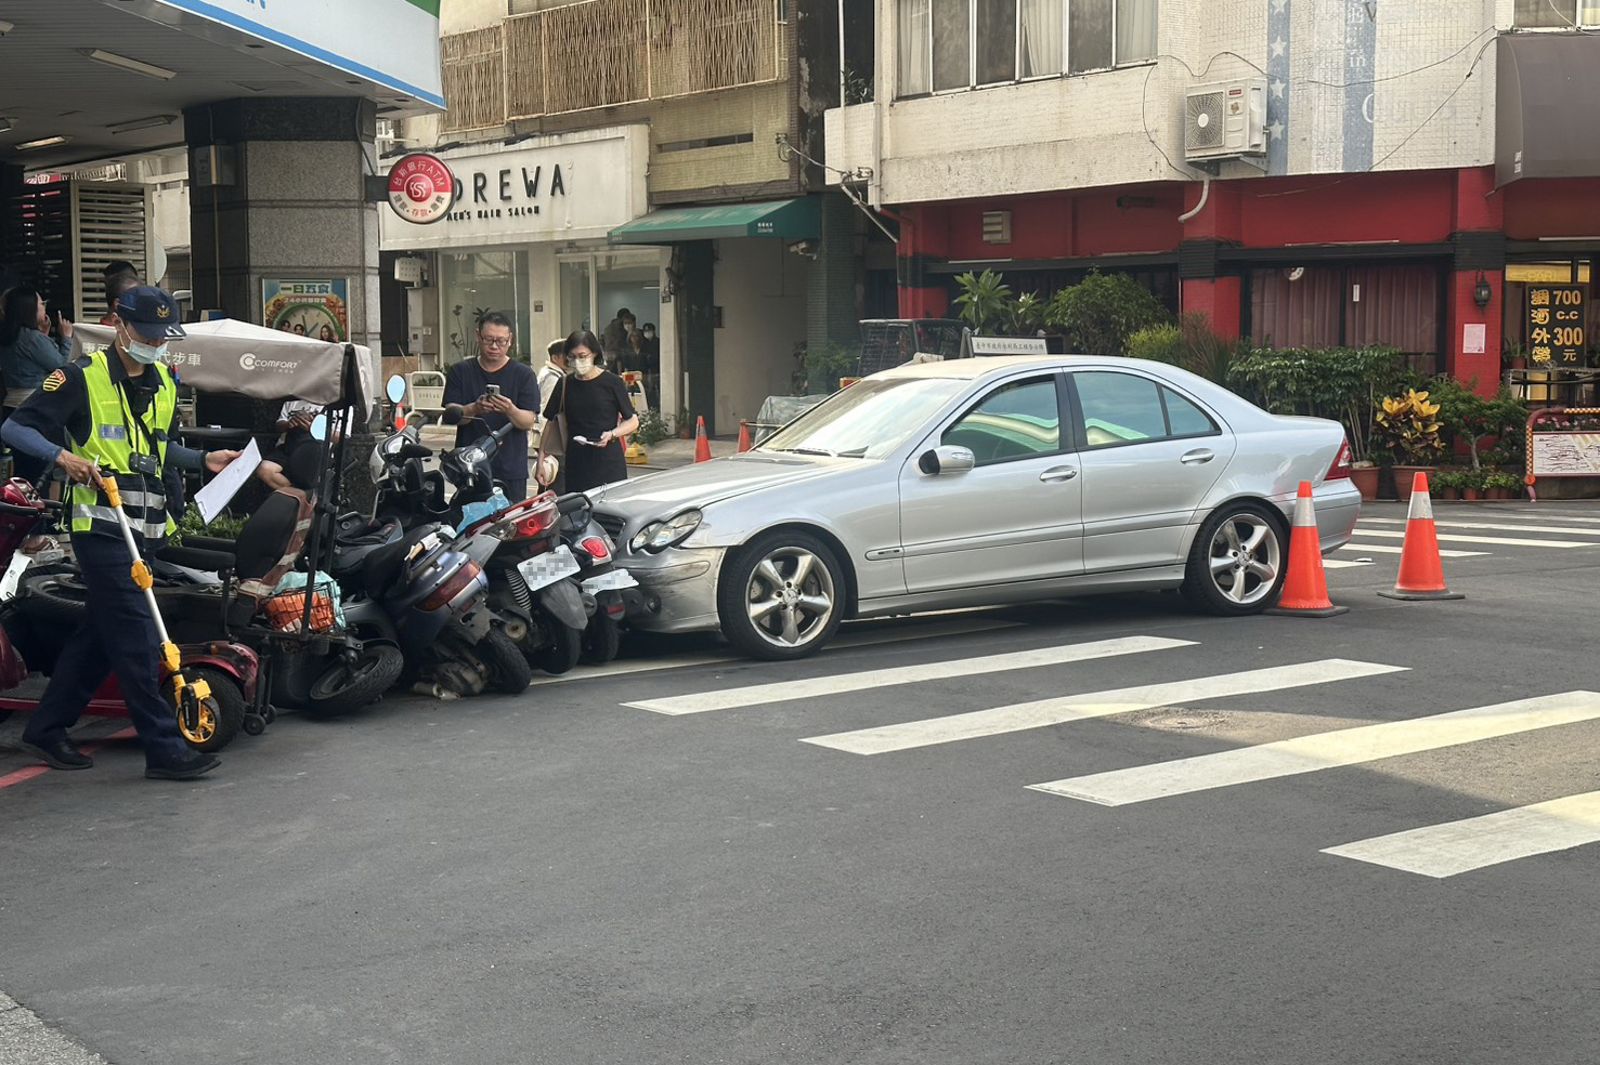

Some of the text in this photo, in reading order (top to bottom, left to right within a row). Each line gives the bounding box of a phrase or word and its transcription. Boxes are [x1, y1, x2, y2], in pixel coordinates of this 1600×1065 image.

[1553, 290, 1581, 305] 700
[1556, 310, 1579, 320] c.c
[1553, 327, 1583, 346] 300
[1563, 349, 1577, 361] 元
[254, 360, 298, 369] COMFORT
